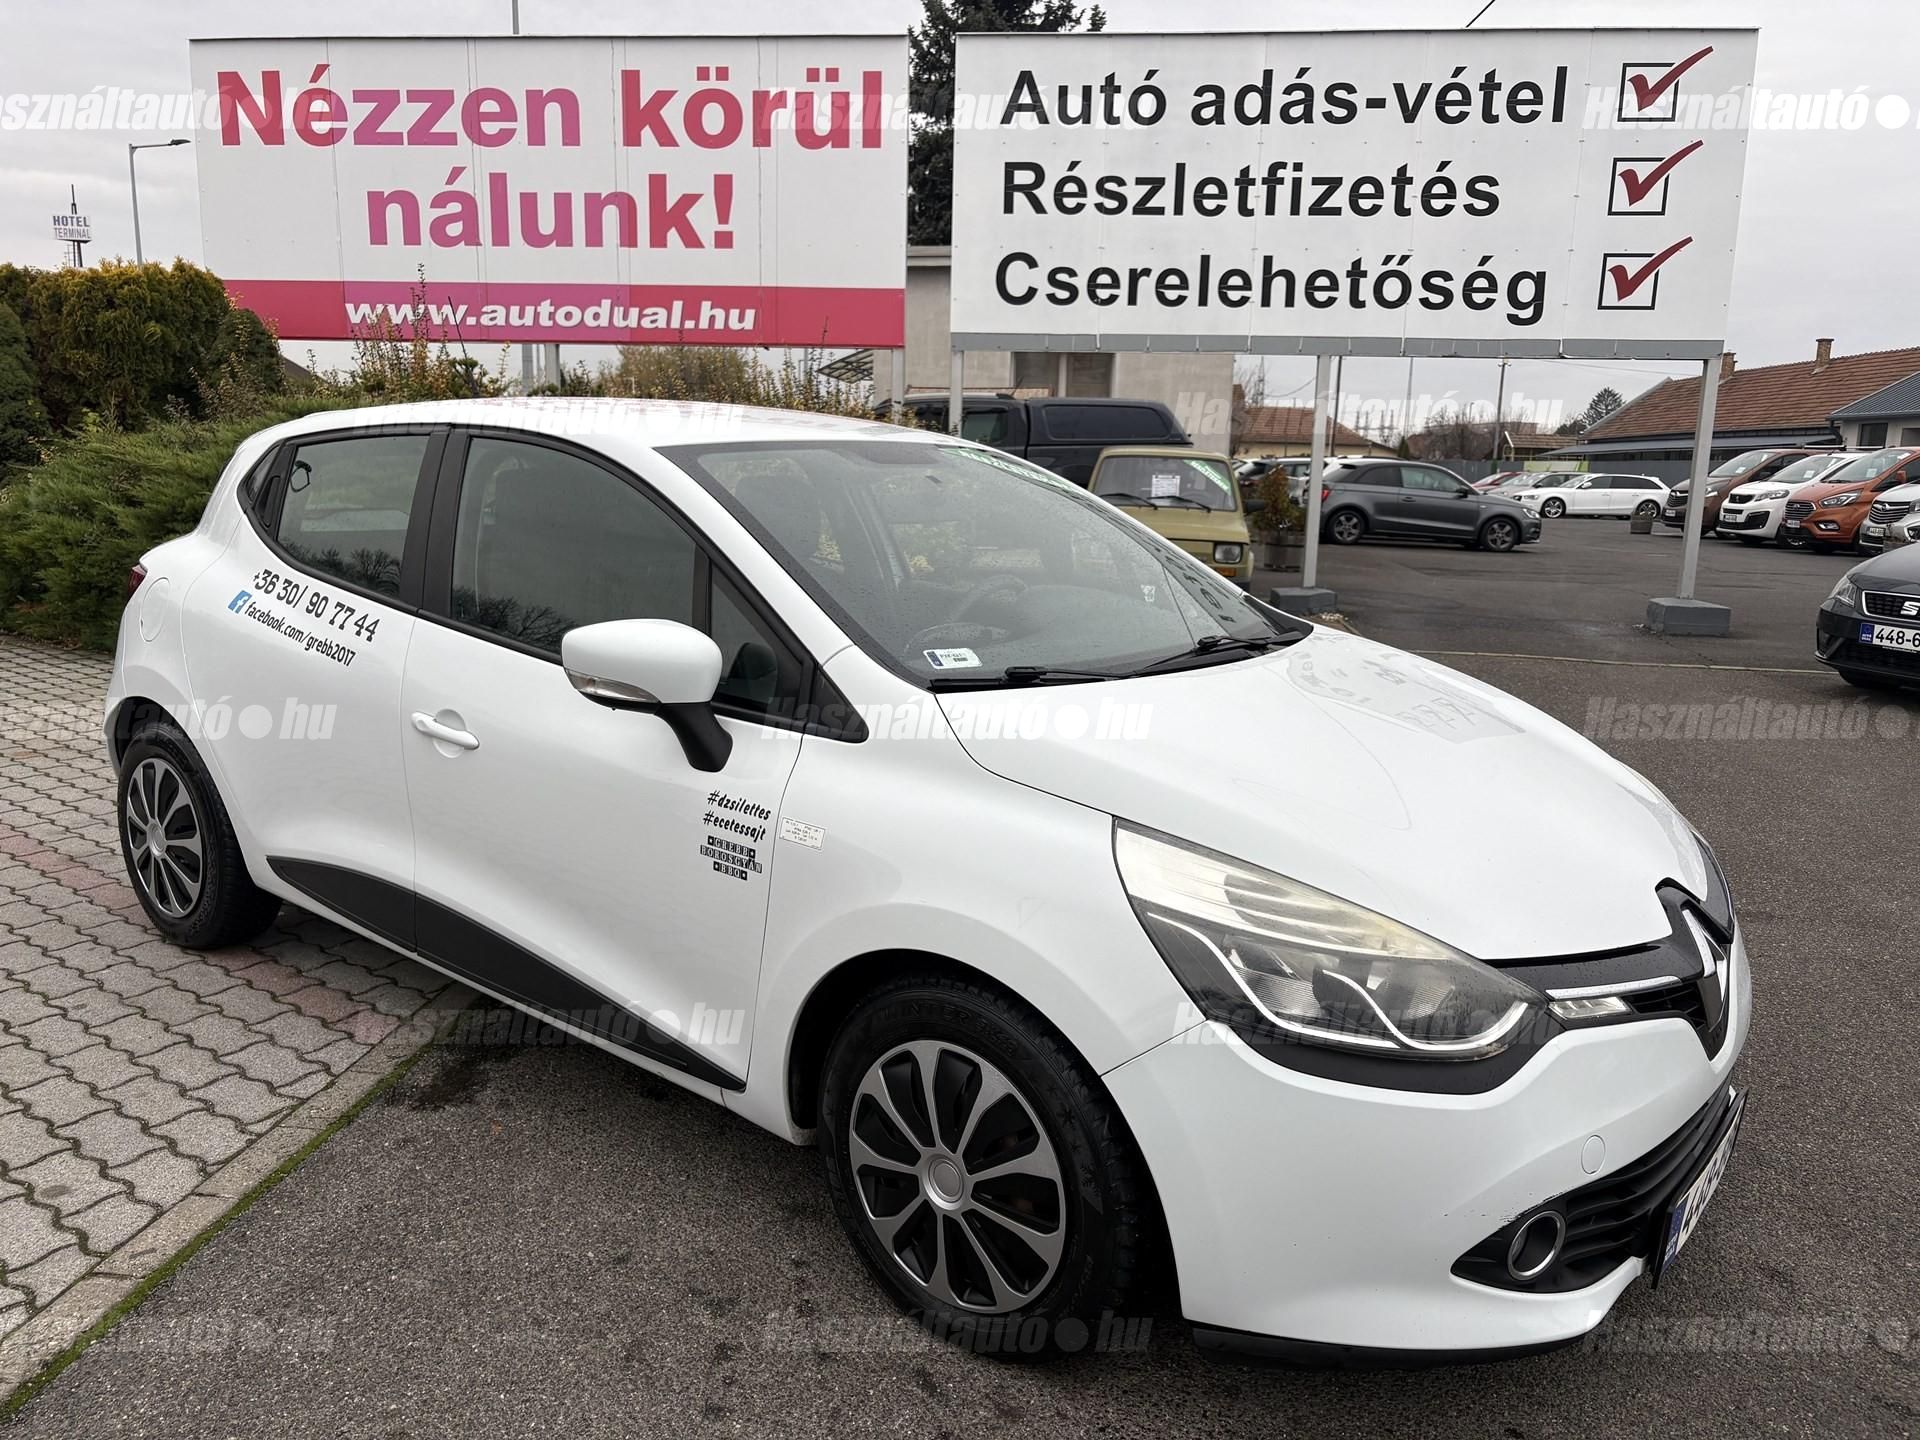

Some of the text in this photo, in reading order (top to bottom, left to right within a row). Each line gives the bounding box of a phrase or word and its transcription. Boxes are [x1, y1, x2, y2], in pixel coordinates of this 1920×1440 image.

[217, 63, 882, 150] Nézzen körül
[1000, 65, 1568, 126] Autó adás-vétel
[367, 167, 734, 249] nálunk!
[1003, 160, 1500, 218] Részletfizetés
[53, 216, 90, 227] HOTEL
[54, 228, 91, 239] TERMINAL
[345, 299, 756, 331] www.autodual.hu
[995, 251, 1547, 326] Cserelehetőség
[244, 601, 356, 666] facebook.com/grebb2017
[252, 569, 380, 642] +36 30/ 90 77 44
[703, 810, 766, 842] #ecetessajt
[707, 790, 771, 820] #dzsilettes
